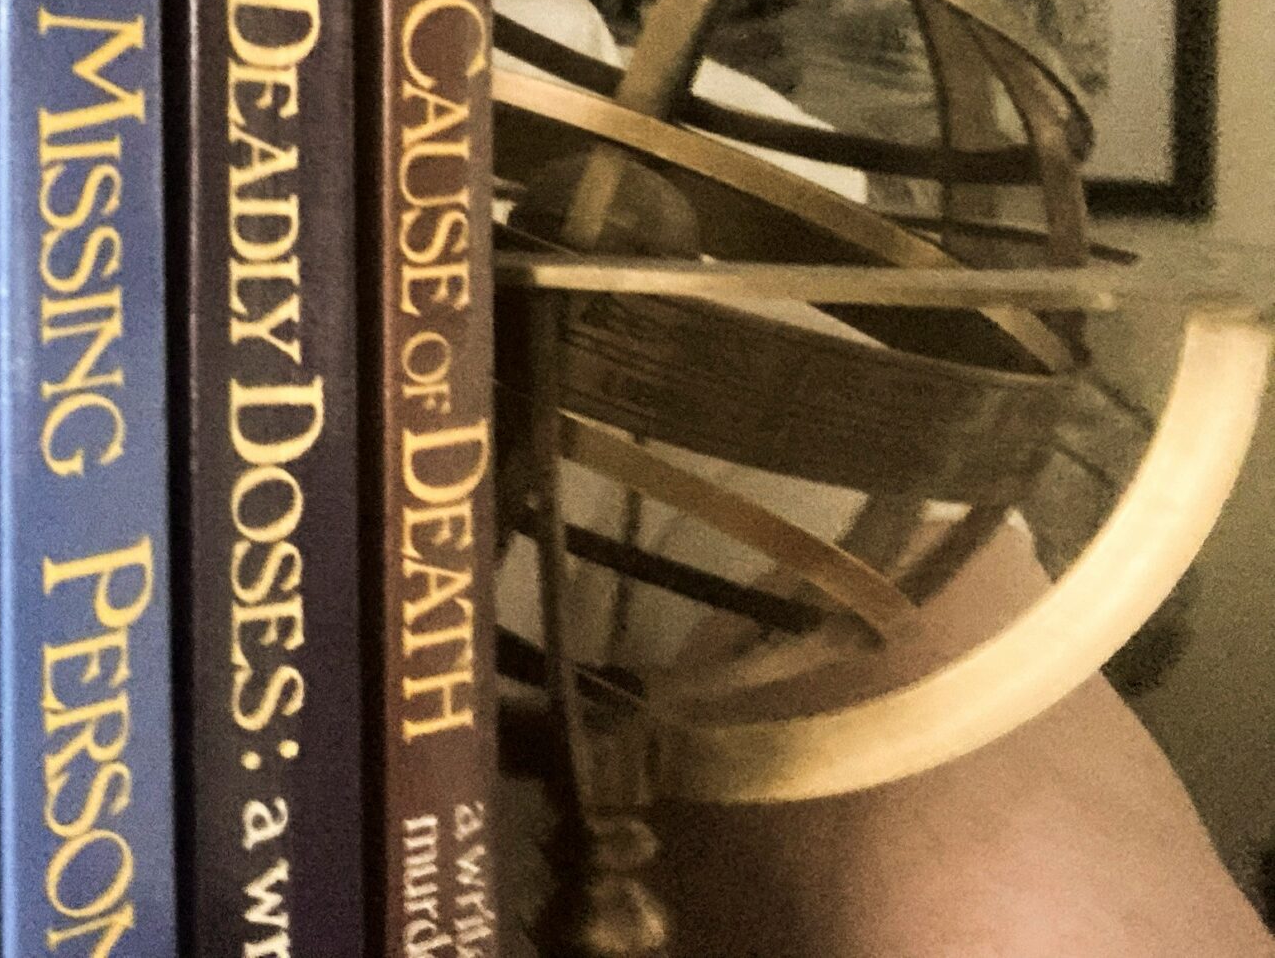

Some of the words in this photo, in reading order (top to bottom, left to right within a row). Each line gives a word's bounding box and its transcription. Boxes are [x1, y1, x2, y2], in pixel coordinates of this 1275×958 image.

[37, 6, 146, 477] MISSING
[401, 331, 452, 414] OF
[228, 376, 326, 771] DOSES:
[402, 418, 491, 746] DEATH
[242, 796, 290, 851] a
[401, 813, 453, 958] murd
[453, 800, 485, 841] a
